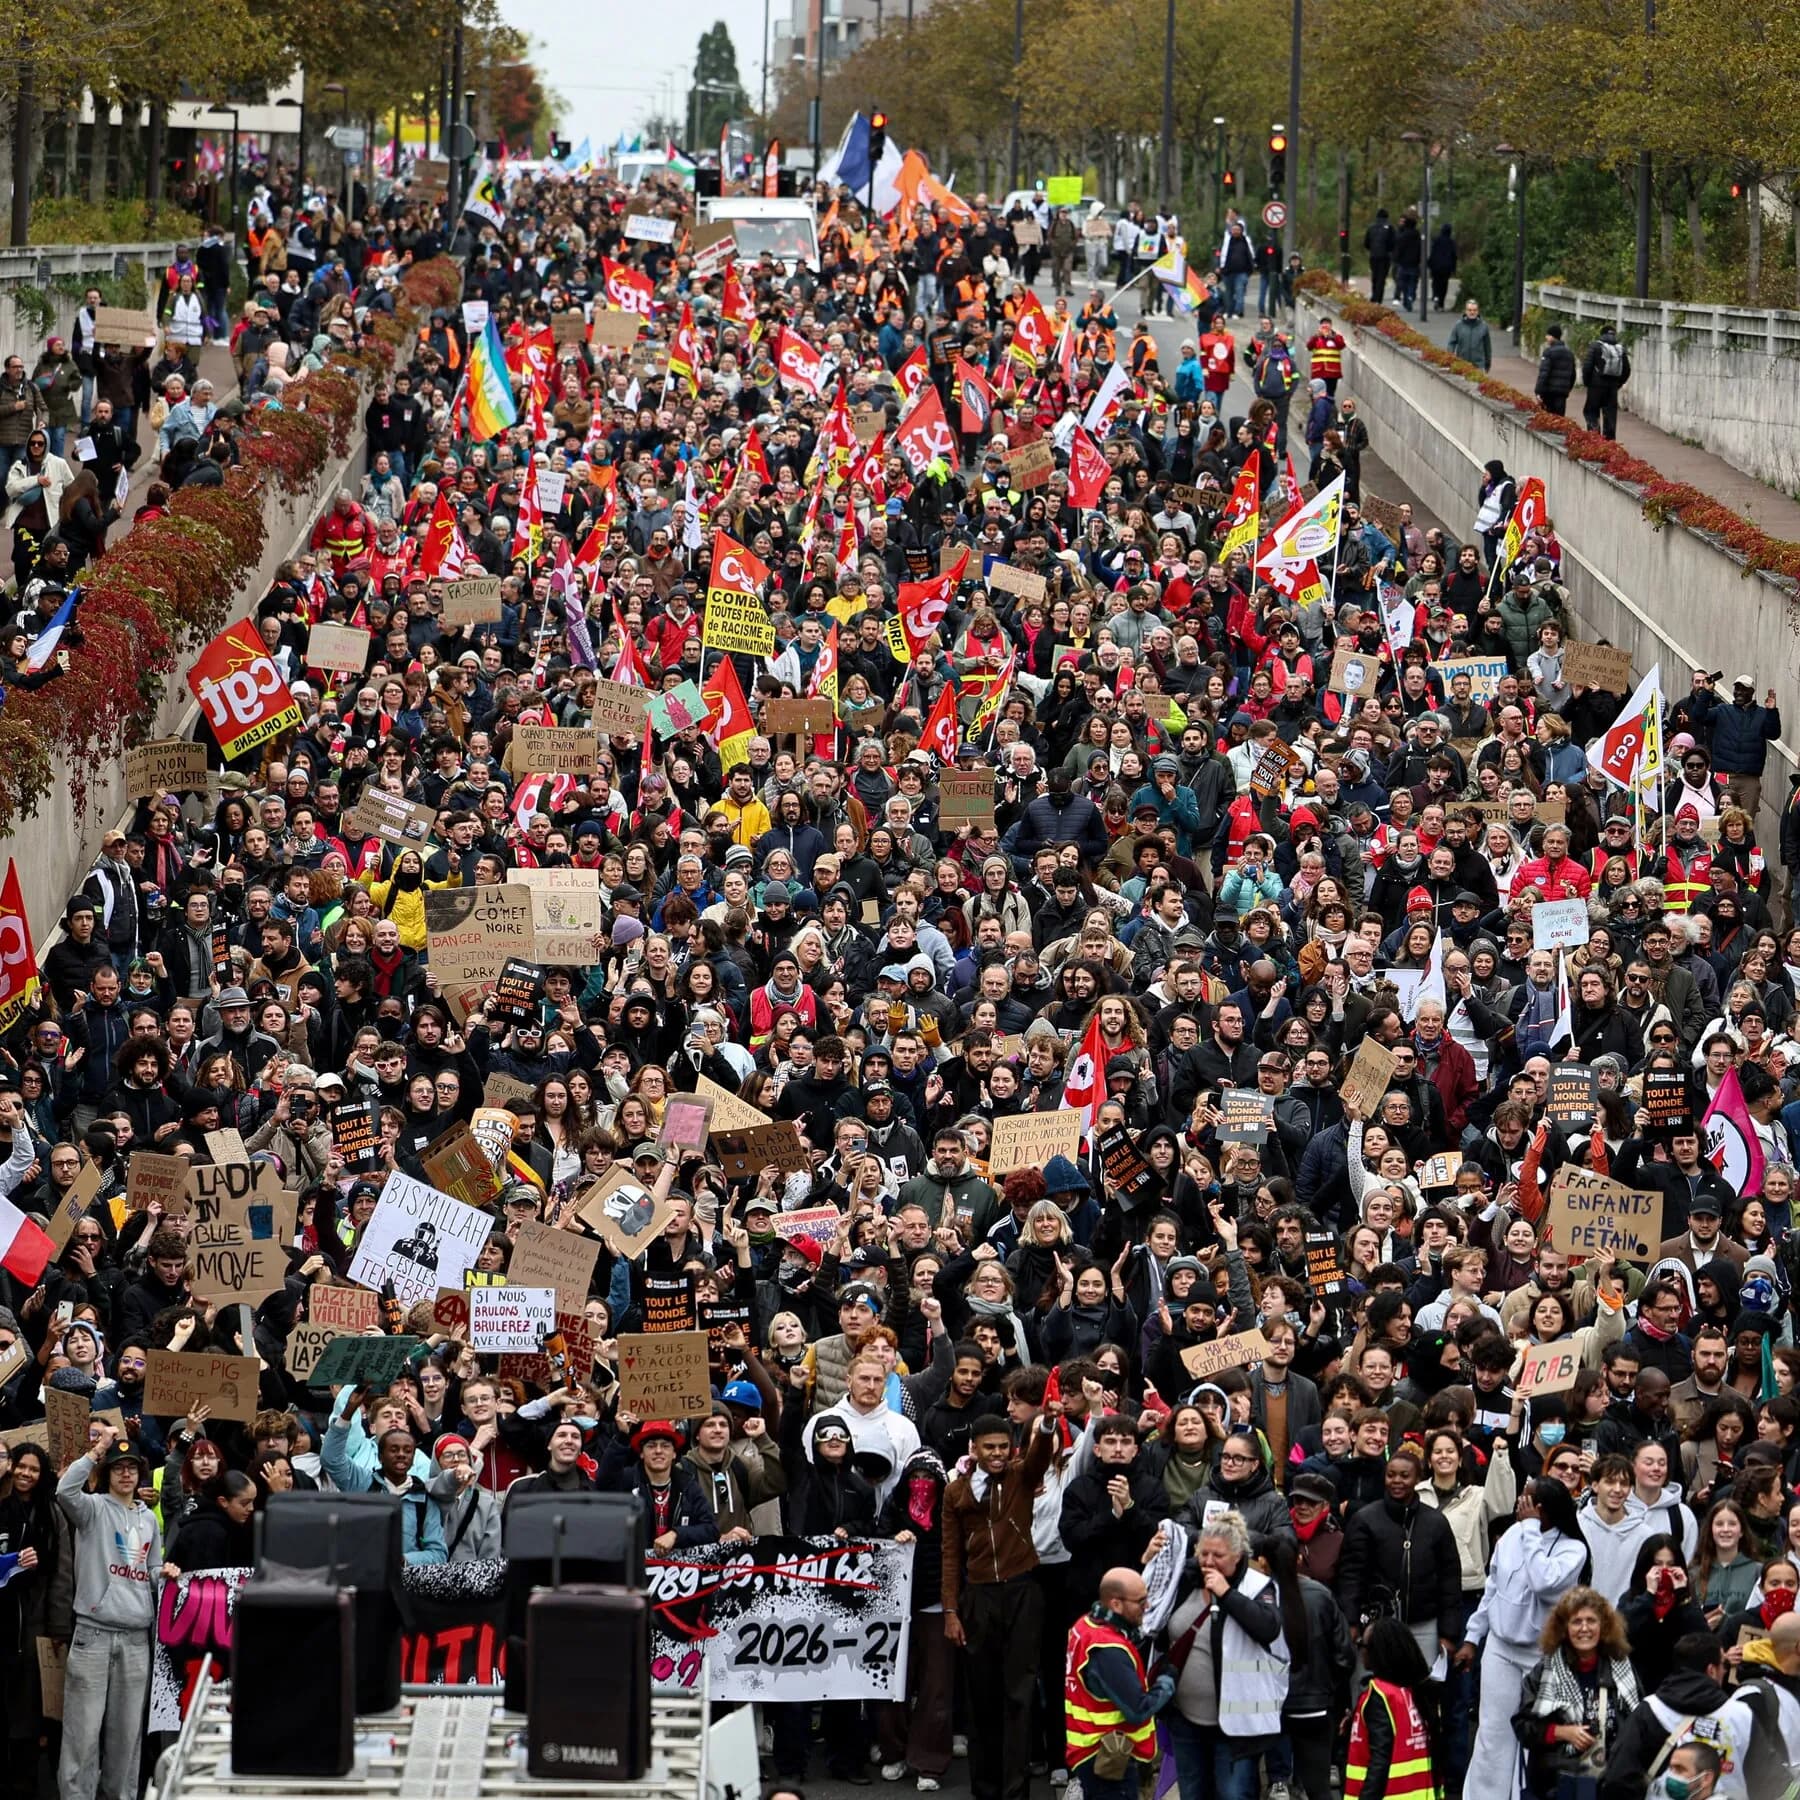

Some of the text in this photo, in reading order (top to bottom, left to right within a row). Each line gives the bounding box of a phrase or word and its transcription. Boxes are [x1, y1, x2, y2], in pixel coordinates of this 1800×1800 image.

[1177, 487, 1193, 498] ON
[447, 580, 498, 600] FASHION
[710, 605, 742, 621] TOUTES
[708, 620, 775, 642] de RACISME et
[716, 635, 772, 655] DISCRIMINATIONS
[601, 680, 615, 692] TOI
[630, 687, 645, 699] VIS
[597, 697, 630, 714] TOI TU
[157, 756, 187, 771] NON
[559, 754, 569, 767] LA
[150, 771, 207, 789] FASCISTES
[941, 782, 994, 796] VIOLENCE
[432, 933, 482, 948] DANGER
[463, 967, 496, 979] DARK
[501, 976, 535, 991] TOUT LE
[499, 987, 531, 999] MONDE
[496, 995, 534, 1010] MMERDE
[500, 1005, 526, 1016] LE RN
[1552, 1082, 1590, 1092] TOUT LE
[1646, 1088, 1684, 1097] TOUT LE
[1226, 1100, 1250, 1108] TOUT
[1554, 1092, 1588, 1101] MONDE
[1648, 1098, 1684, 1108] MONDE
[1548, 1103, 1594, 1112] EMMERDE
[1648, 1107, 1690, 1118] MMERDE
[996, 1113, 1080, 1132] LORSQUE MANIFESTER
[1226, 1115, 1268, 1124] MMERDE
[1571, 1111, 1586, 1120] RN
[1667, 1116, 1682, 1125] RN
[336, 1115, 373, 1132] TOUT LE
[478, 1120, 513, 1138] SI ON
[1243, 1123, 1258, 1131] RN
[339, 1127, 373, 1141] MONDE
[753, 1130, 793, 1146] LADY
[1020, 1129, 1039, 1142] PLUS
[347, 1148, 374, 1163] LE RN
[771, 1143, 800, 1156] BLUE
[993, 1143, 1070, 1169] UN DEVOIR
[1104, 1144, 1130, 1167] TOUT LE
[767, 1156, 805, 1168] MOVE
[1110, 1154, 1136, 1177] MONDE
[197, 1162, 266, 1199] LADY
[1126, 1171, 1150, 1193] LE RN
[194, 1197, 220, 1223] IN
[1568, 1194, 1654, 1215] ENFANTS
[386, 1177, 488, 1248] BISMILLAH
[1598, 1215, 1614, 1228] DE
[194, 1224, 241, 1244] BLUE
[1307, 1247, 1336, 1261] TOUT LE
[197, 1251, 264, 1287] MOVE
[1310, 1259, 1336, 1272] MONDE
[416, 1261, 437, 1287] LES
[312, 1286, 354, 1306] GAZEZ
[1316, 1282, 1340, 1296] LE RN
[476, 1290, 527, 1304] SI NOUS
[645, 1294, 688, 1308] TOUT LE
[525, 1307, 552, 1318] VOUS
[648, 1307, 686, 1319] MONDE
[474, 1321, 531, 1333] BRULEREZ
[643, 1317, 693, 1333] EMMERDE
[473, 1334, 536, 1347] AVEC NOUS
[627, 1344, 684, 1356] JE SUIS
[1239, 1346, 1261, 1363] 2026
[154, 1359, 193, 1376] Better
[211, 1360, 240, 1380] PIG
[629, 1369, 692, 1383] AVEC LES
[1522, 1355, 1574, 1386] ACAB
[151, 1387, 208, 1405] FASCIST
[642, 1382, 684, 1395] AUTRES
[109, 1563, 150, 1582] adidas
[774, 1552, 873, 1588] MAI 68
[562, 1744, 619, 1766] YAMAHA
